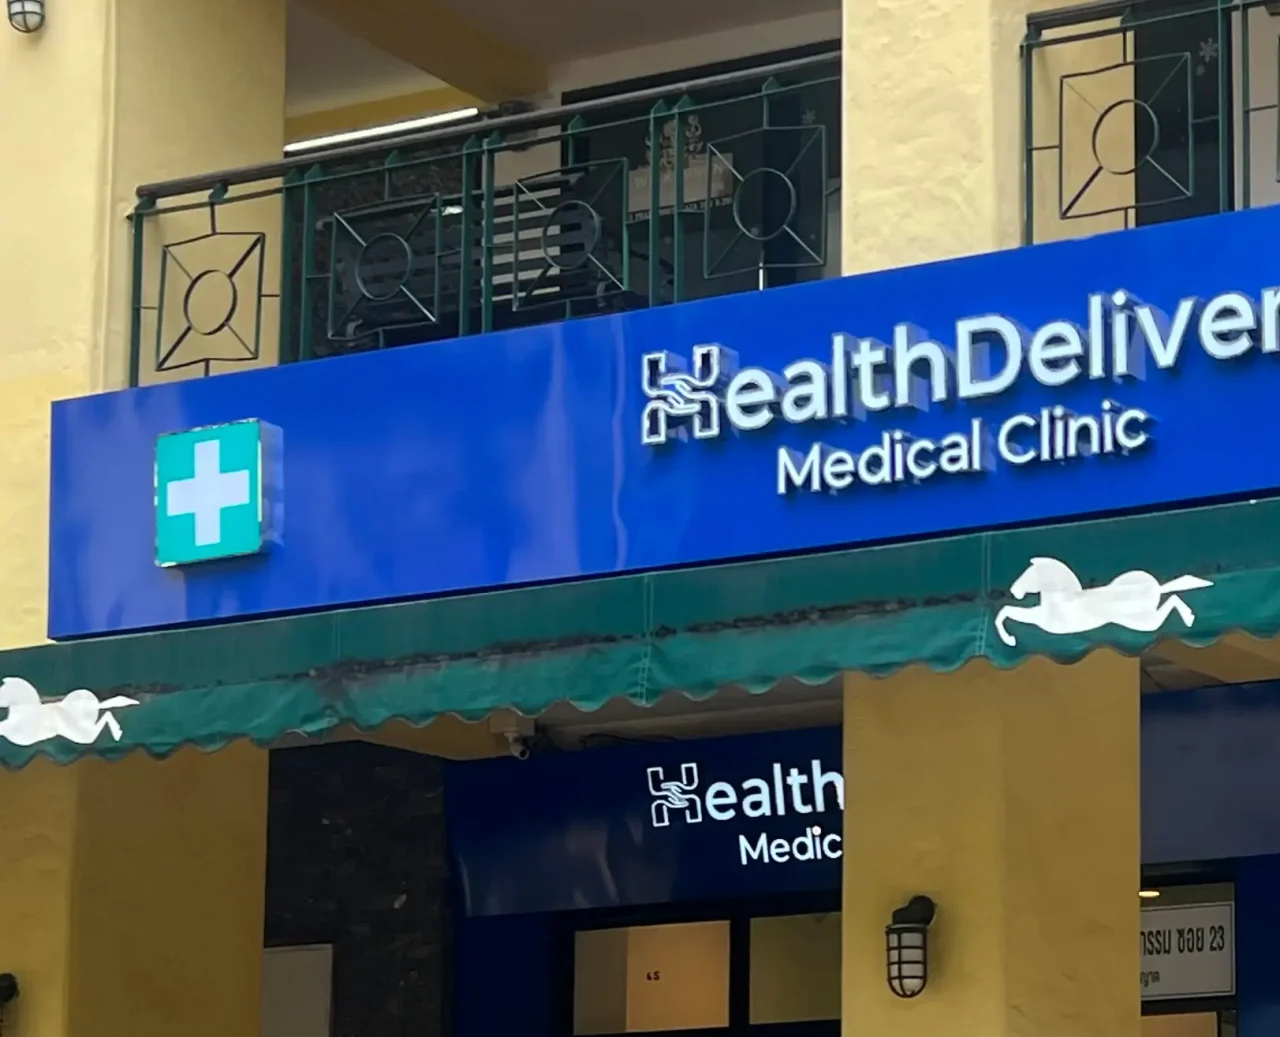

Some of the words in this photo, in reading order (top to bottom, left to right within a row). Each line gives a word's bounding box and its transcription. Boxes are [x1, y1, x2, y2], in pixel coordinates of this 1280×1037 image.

[777, 419, 982, 496] Medical
[998, 400, 1149, 466] Clinic
[739, 825, 844, 866] Medic
[1209, 925, 1225, 952] 23
